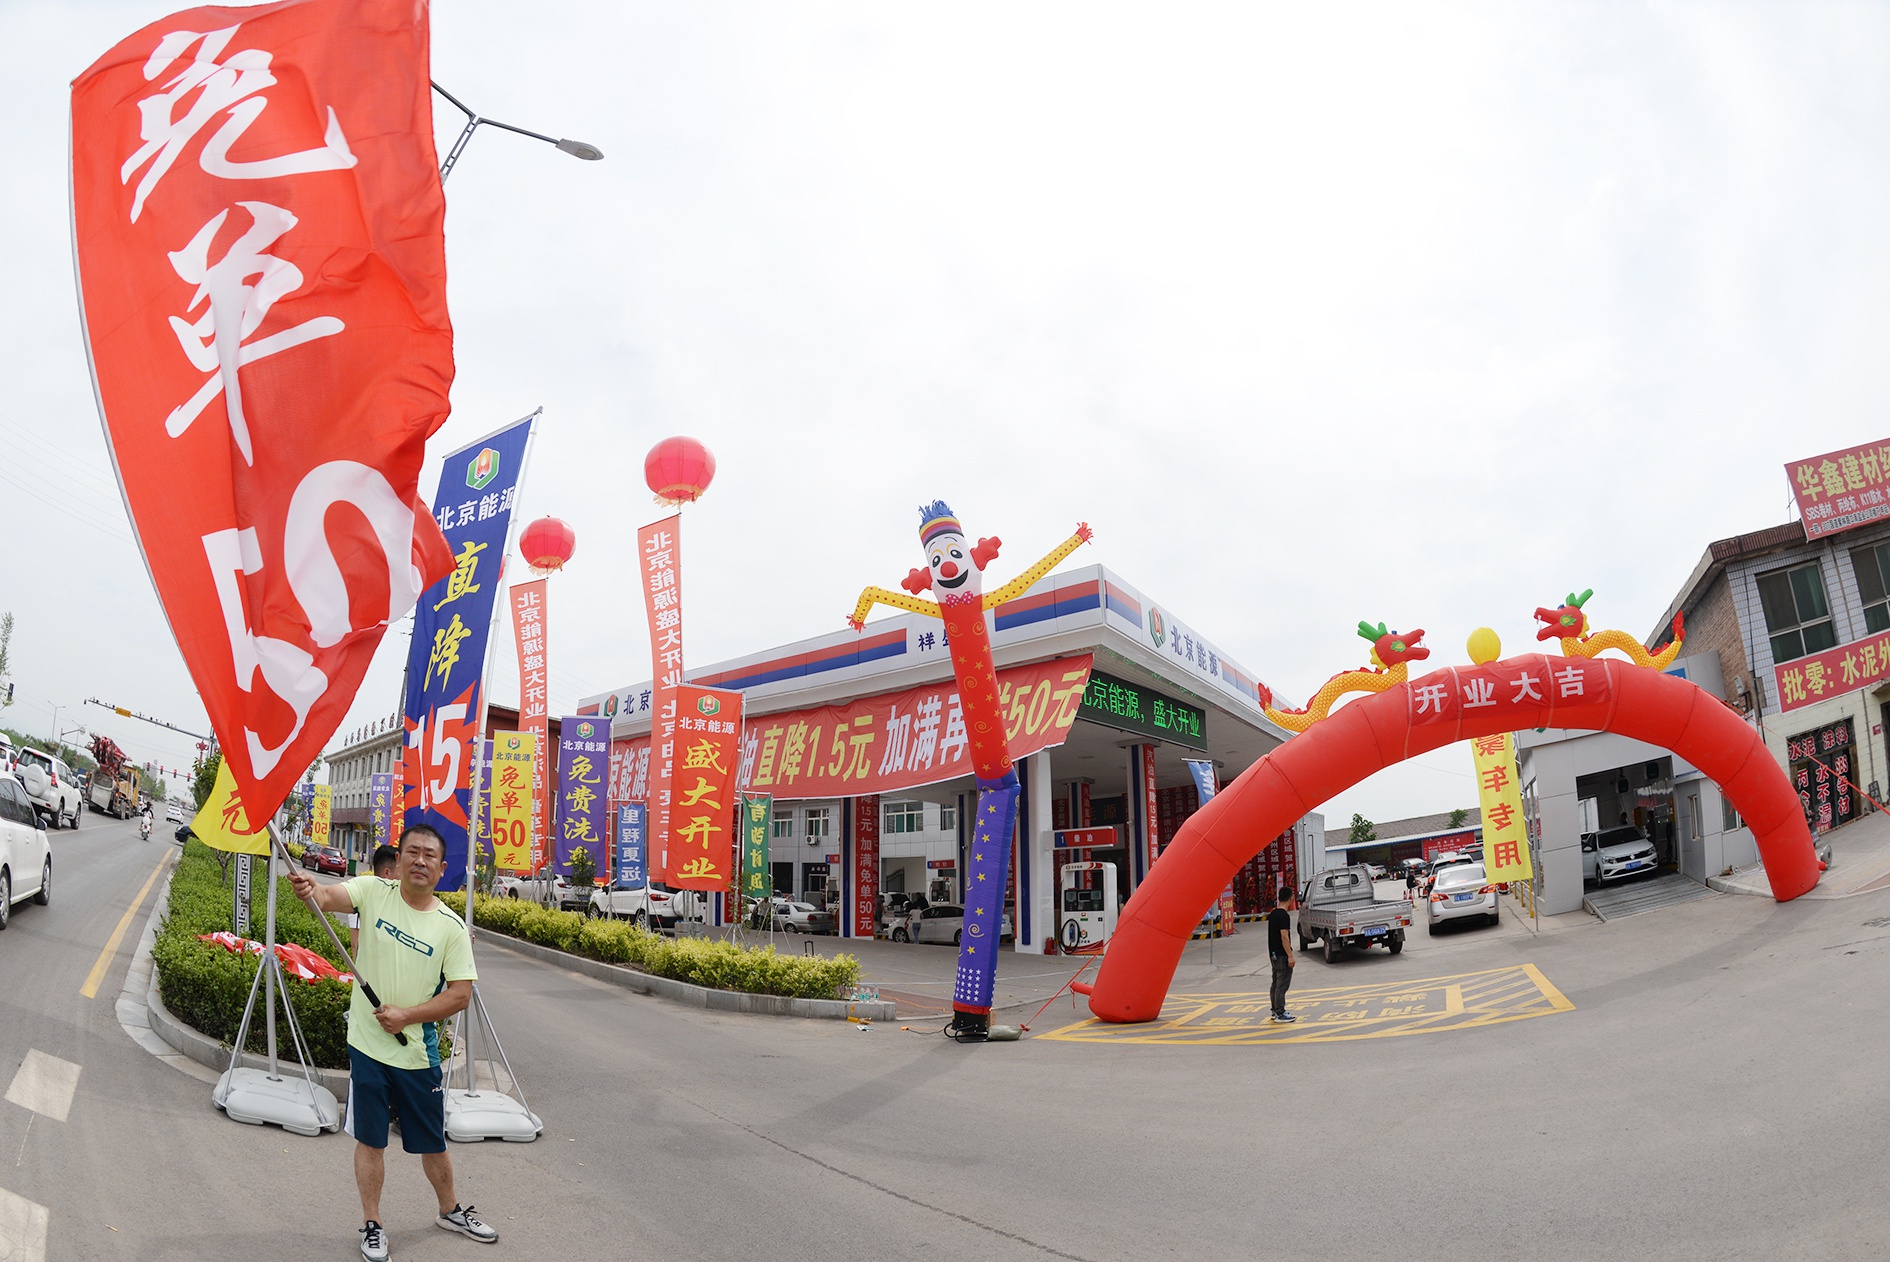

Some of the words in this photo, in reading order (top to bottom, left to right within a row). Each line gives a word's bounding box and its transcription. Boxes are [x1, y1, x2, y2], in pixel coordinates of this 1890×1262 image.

[120, 23, 358, 467] 免单
[436, 486, 516, 532] 北京能源
[1171, 625, 1218, 677] 北京能源
[1415, 666, 1584, 714] 开业大吉
[563, 740, 607, 753] 北京能源
[679, 716, 735, 735] 北京能源
[1788, 736, 1817, 760] 水泥
[495, 752, 531, 762] 北京能源
[676, 738, 730, 880] 盛大开业
